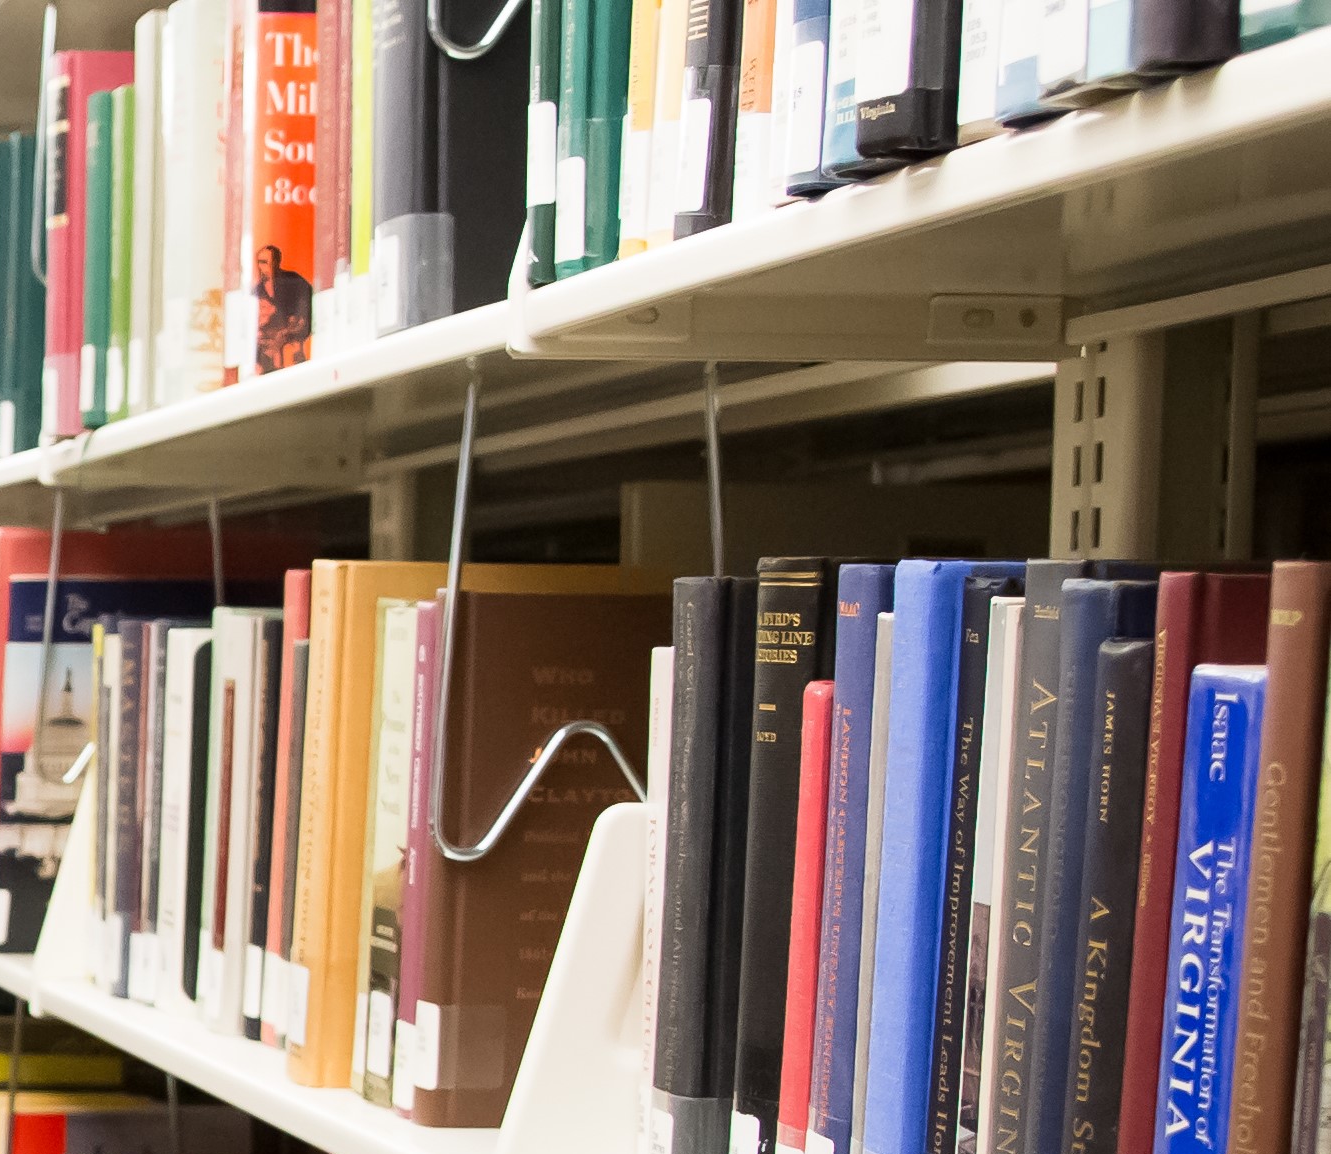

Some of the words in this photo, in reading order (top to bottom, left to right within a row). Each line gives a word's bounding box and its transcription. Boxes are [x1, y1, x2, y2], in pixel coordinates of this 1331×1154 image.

[859, 101, 897, 121] Virginia
[780, 630, 816, 646] LINE
[959, 716, 975, 766] The
[1103, 689, 1116, 755] JAMES
[1208, 691, 1239, 784] Isaac
[530, 786, 633, 803] CLAYTO
[954, 773, 971, 824] Way
[1013, 680, 1058, 947] ATLANTIC
[1098, 764, 1112, 825] HORN
[953, 833, 967, 859] of
[1213, 836, 1238, 896] The
[1252, 761, 1287, 945] Gentlemen
[1089, 896, 1111, 921] A
[942, 861, 966, 1027] Improvement
[1164, 839, 1214, 1139] VIRGINIA
[1197, 902, 1234, 1106] Transformation
[1246, 958, 1269, 1021] and
[1076, 938, 1110, 1103] Kingdom
[937, 1034, 954, 1103] Leads
[1194, 1114, 1214, 1151] of
